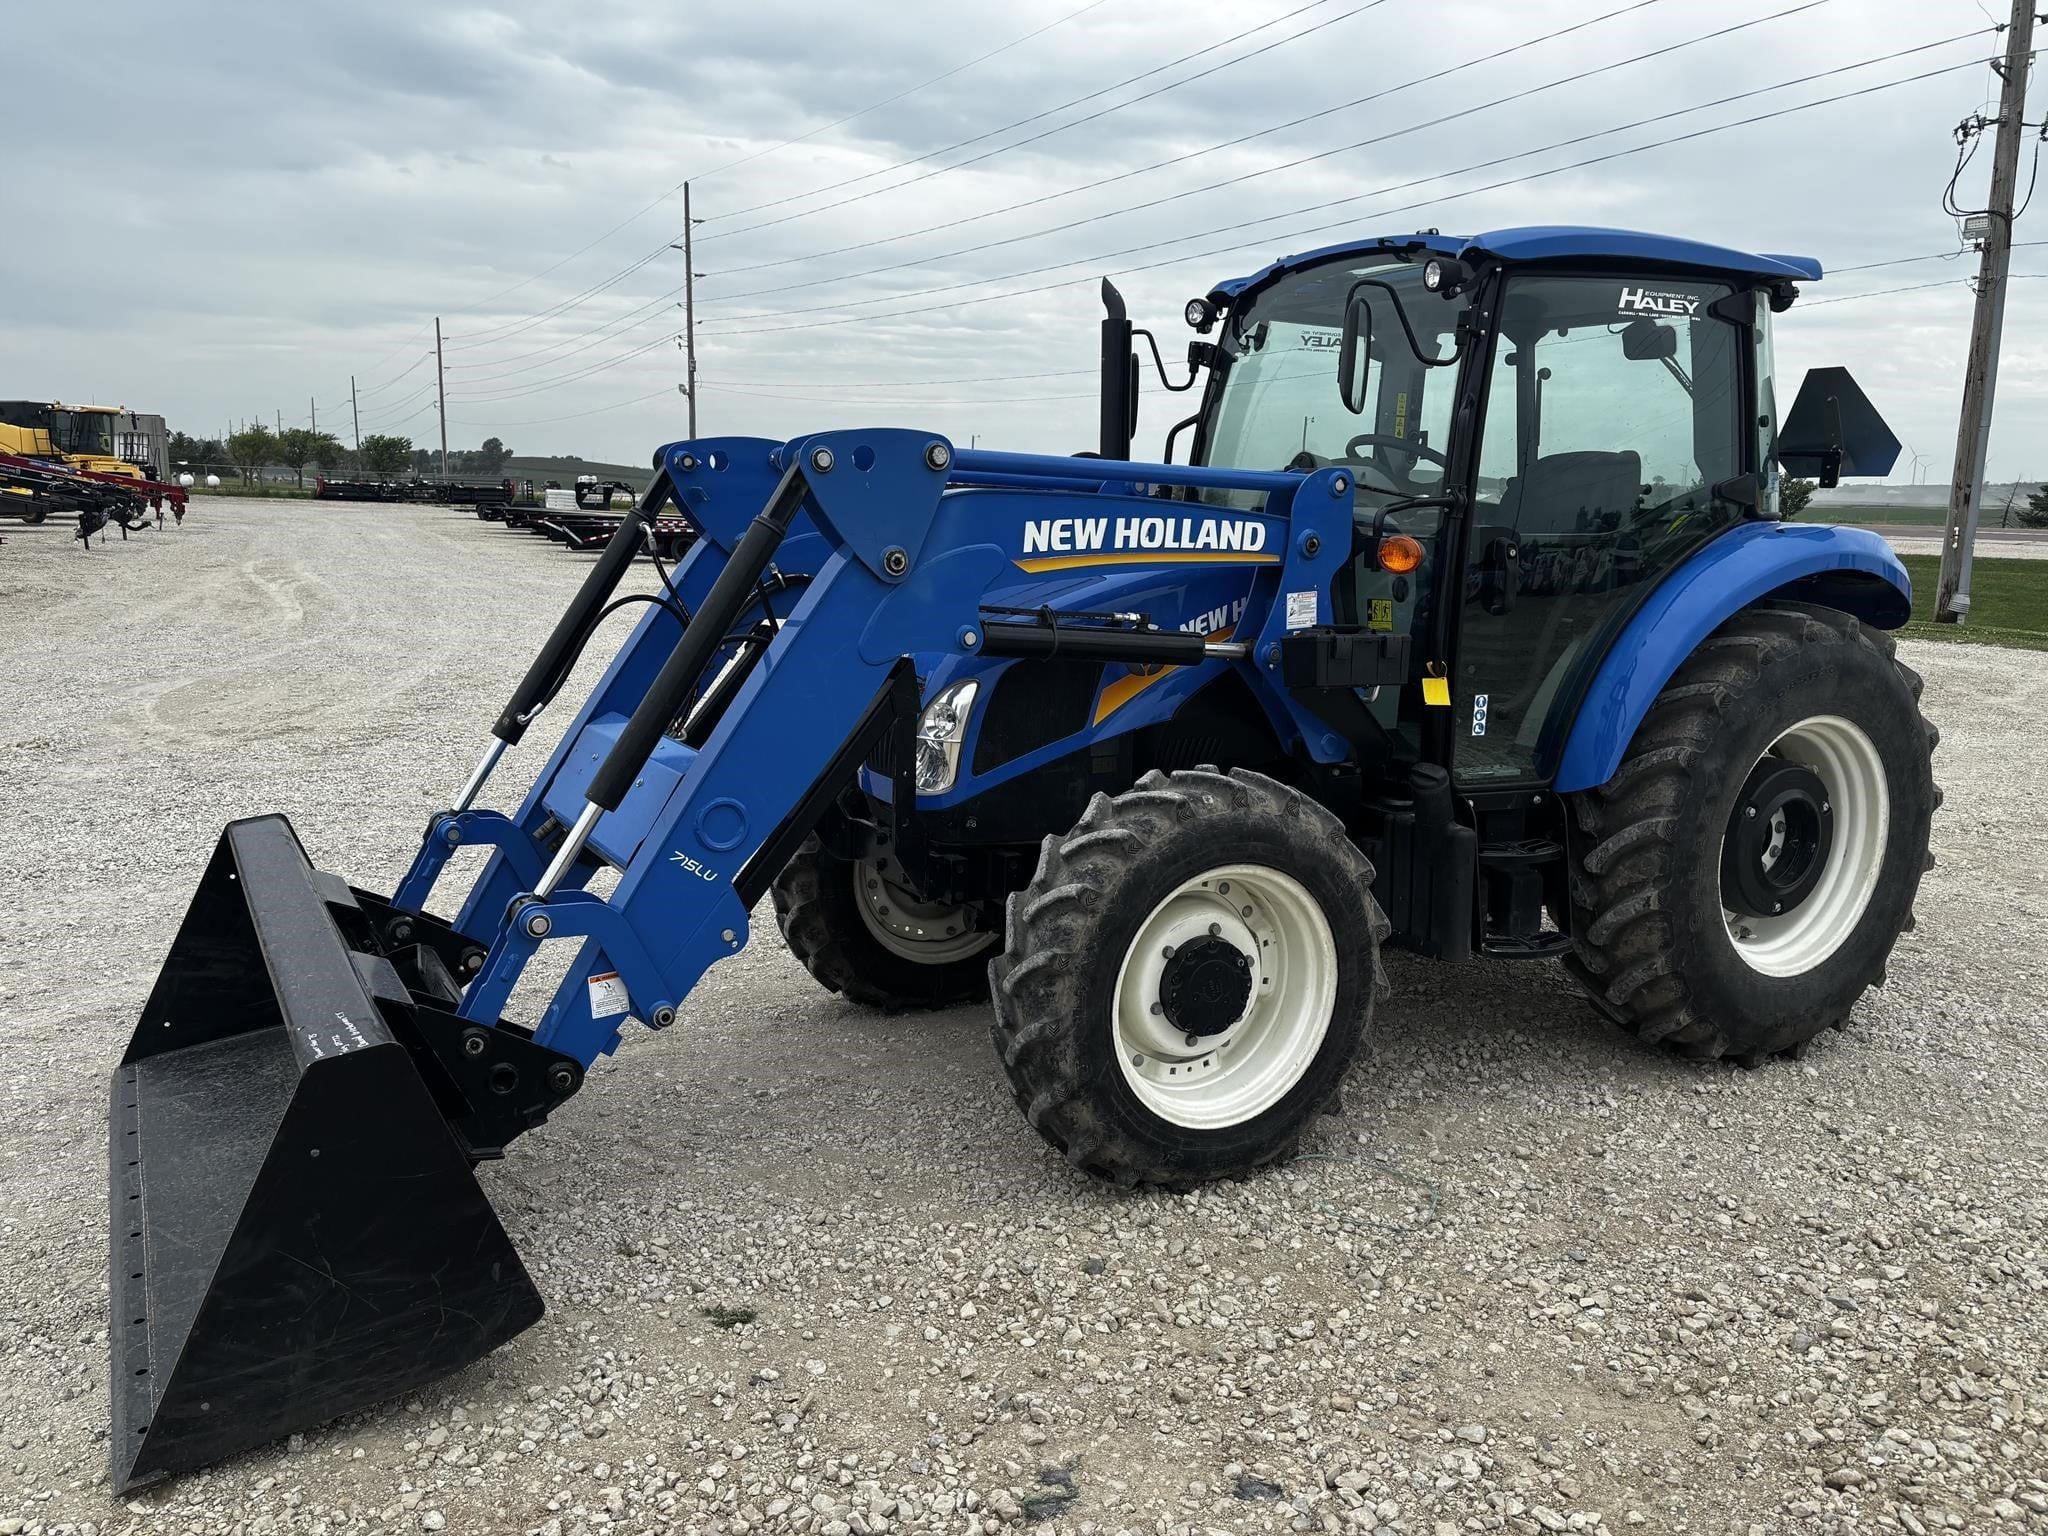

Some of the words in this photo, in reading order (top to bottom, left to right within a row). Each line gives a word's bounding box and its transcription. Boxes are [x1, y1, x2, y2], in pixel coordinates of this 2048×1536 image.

[1618, 287, 1699, 314] HALEY
[1022, 518, 1108, 553] NEW
[1114, 518, 1266, 552] HOLLAND
[1179, 604, 1228, 636] NEW
[669, 851, 718, 881] 715LU
